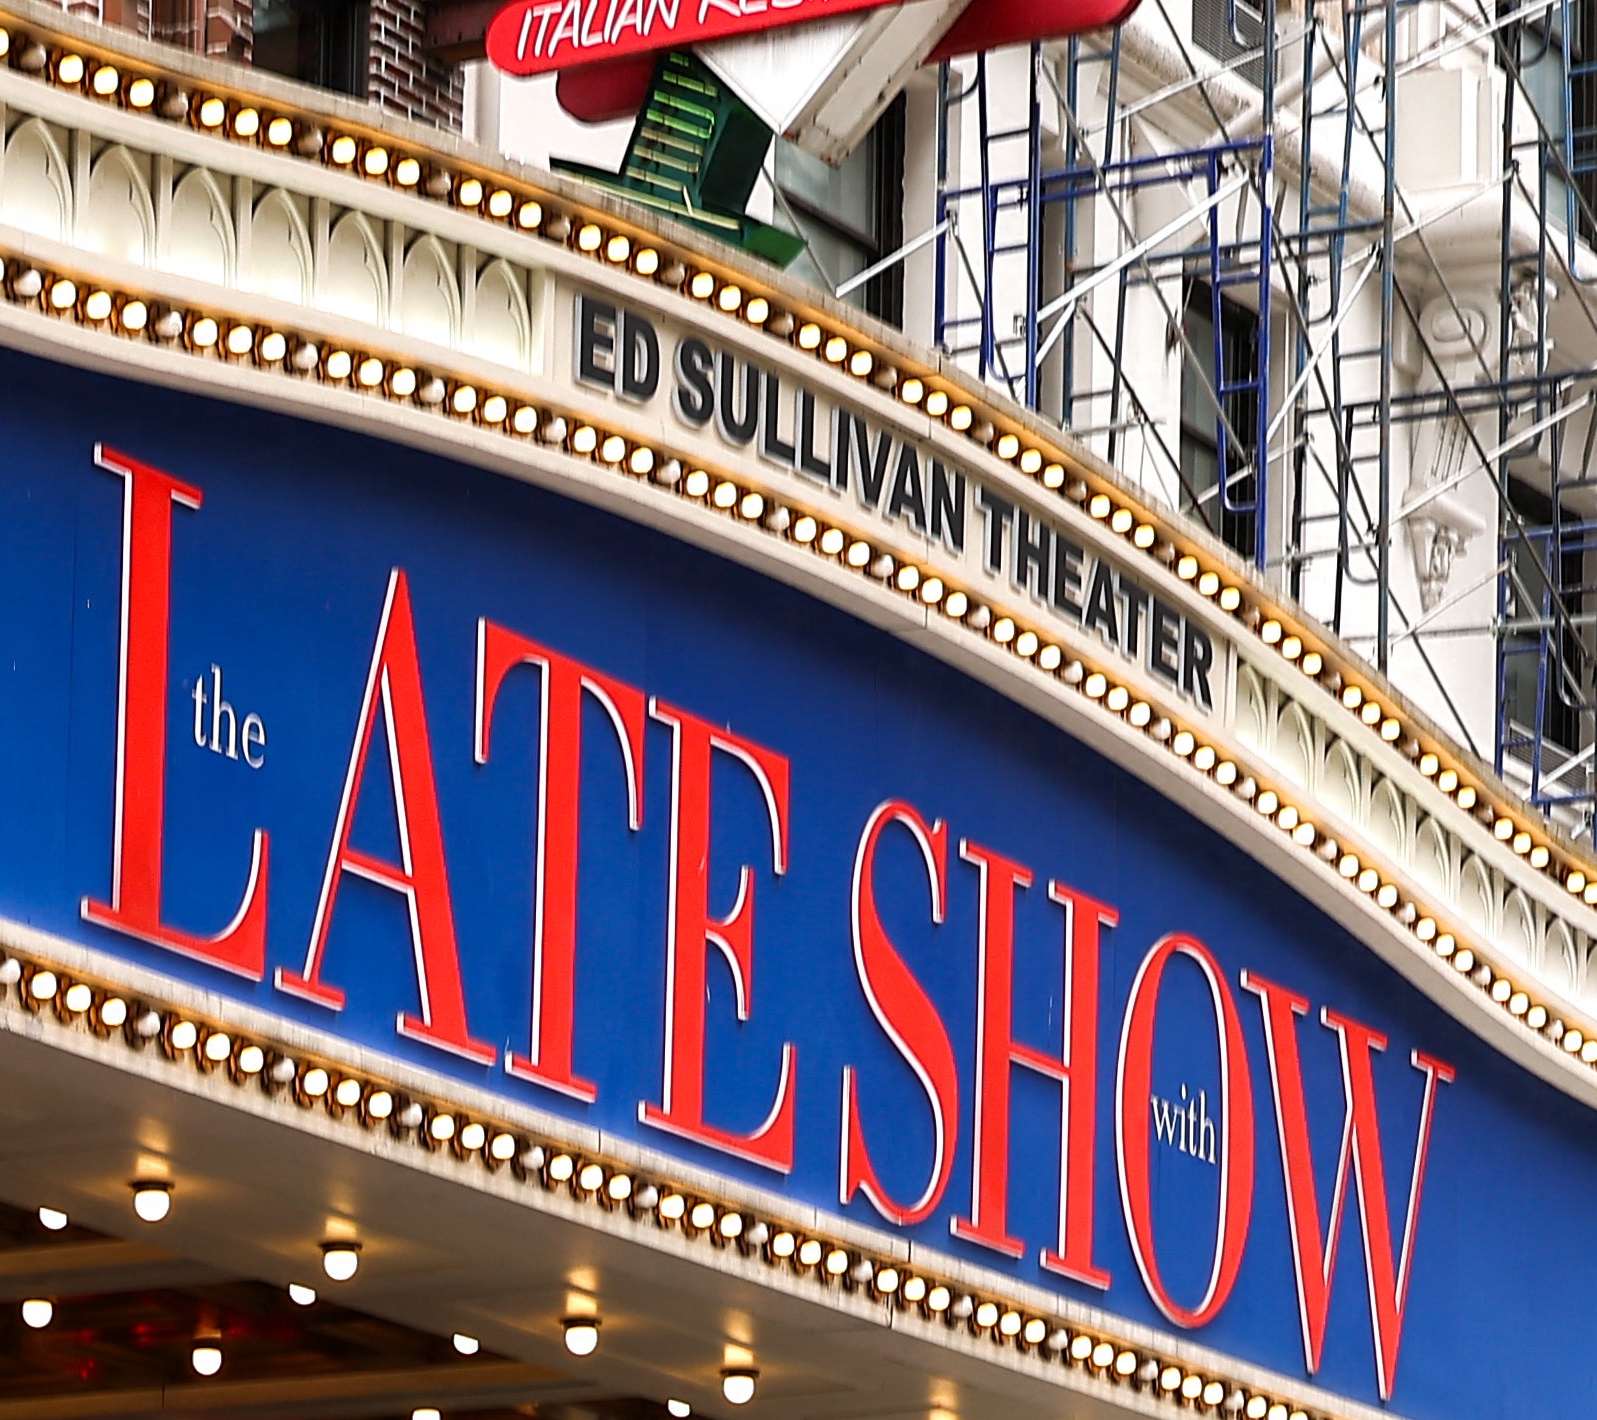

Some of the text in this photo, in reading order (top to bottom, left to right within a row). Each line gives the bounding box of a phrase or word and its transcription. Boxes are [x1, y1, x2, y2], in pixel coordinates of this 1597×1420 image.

[517, 0, 679, 61] ITALIAN
[575, 293, 1215, 711] ED SULLIVAN THEATER
[81, 442, 1455, 1402] the LATE SHOW
[1150, 1083, 1218, 1164] with
